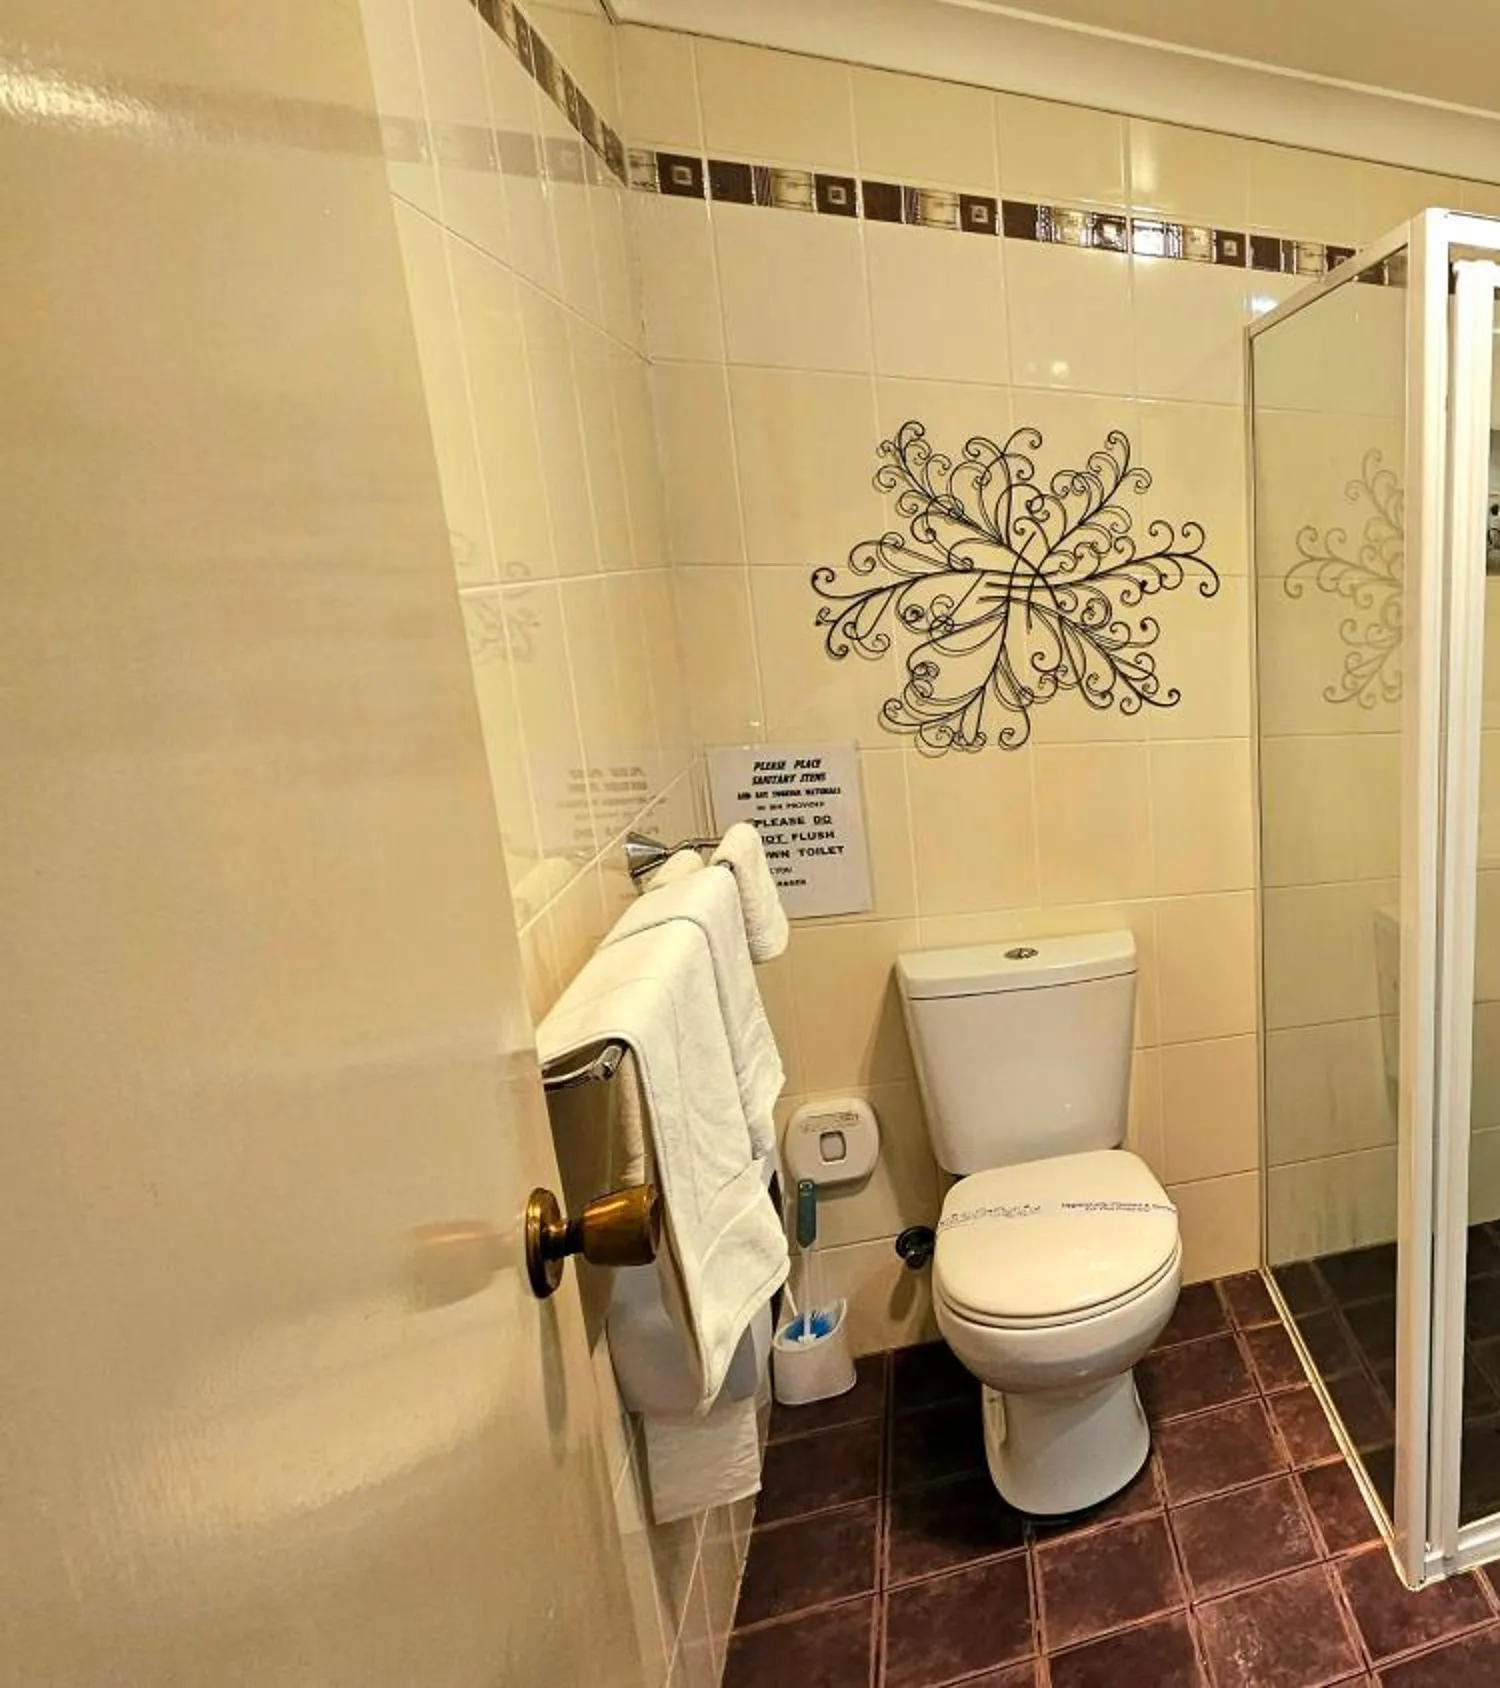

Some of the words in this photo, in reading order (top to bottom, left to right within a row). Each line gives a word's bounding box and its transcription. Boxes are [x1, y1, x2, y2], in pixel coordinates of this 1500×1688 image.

[754, 760, 786, 771] PLEASE
[794, 758, 821, 769] PLACE
[752, 774, 797, 785] SANITARY
[754, 816, 805, 828] PLEASE
[813, 815, 832, 826] DO
[791, 831, 835, 841] FLUSH
[798, 846, 844, 857] TOILET
